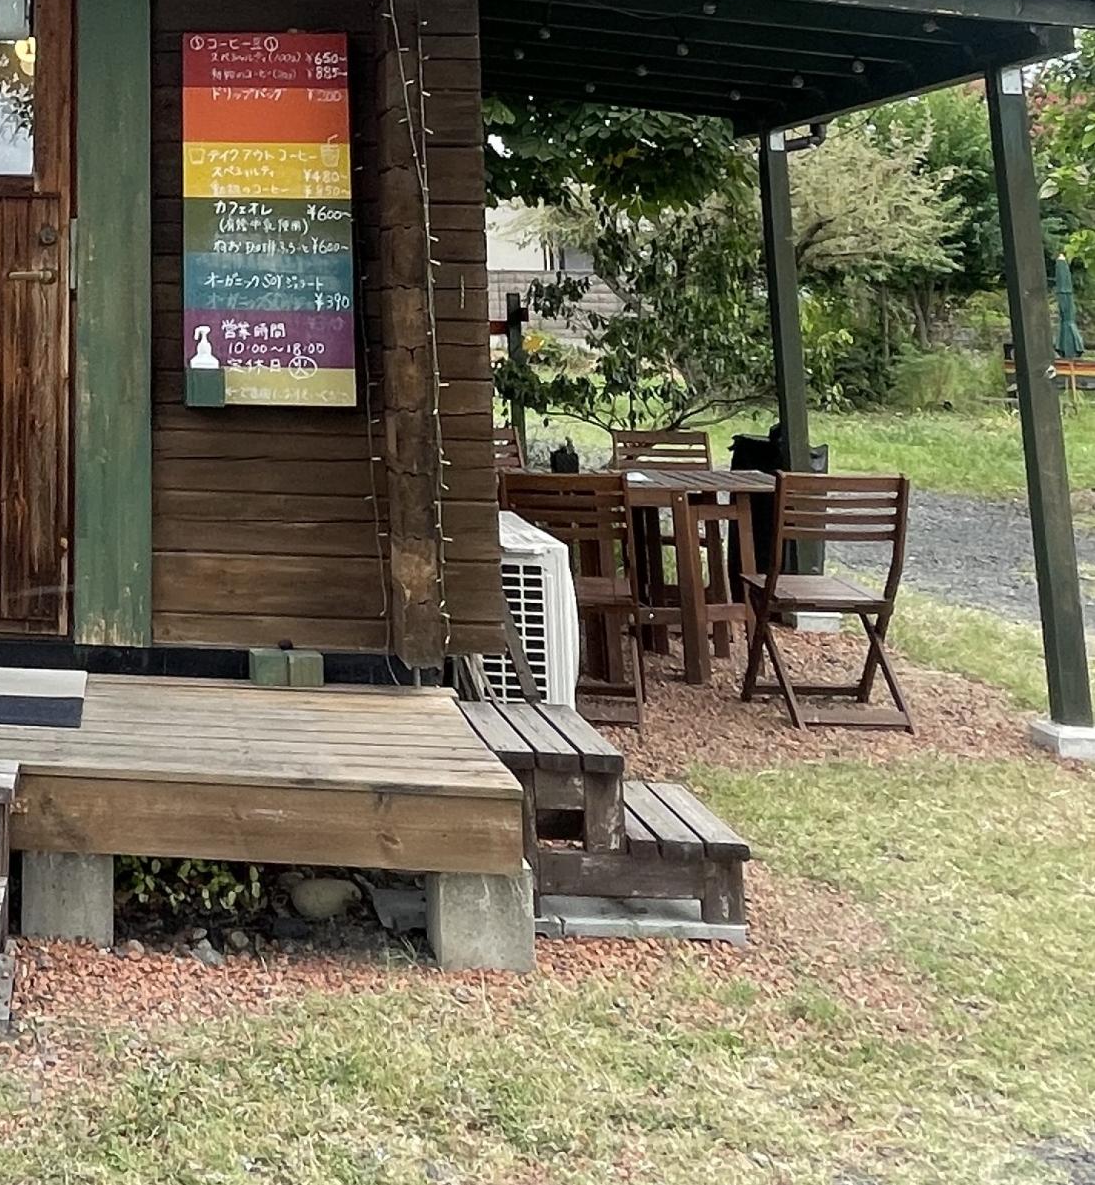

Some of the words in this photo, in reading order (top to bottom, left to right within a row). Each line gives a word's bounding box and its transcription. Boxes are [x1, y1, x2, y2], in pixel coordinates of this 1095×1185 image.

[207, 37, 262, 51] コーヒー豆
[213, 200, 273, 215] カフェオレ
[314, 292, 350, 312] ¥390
[221, 318, 287, 340] 営業時間
[226, 358, 283, 375] 定休日
